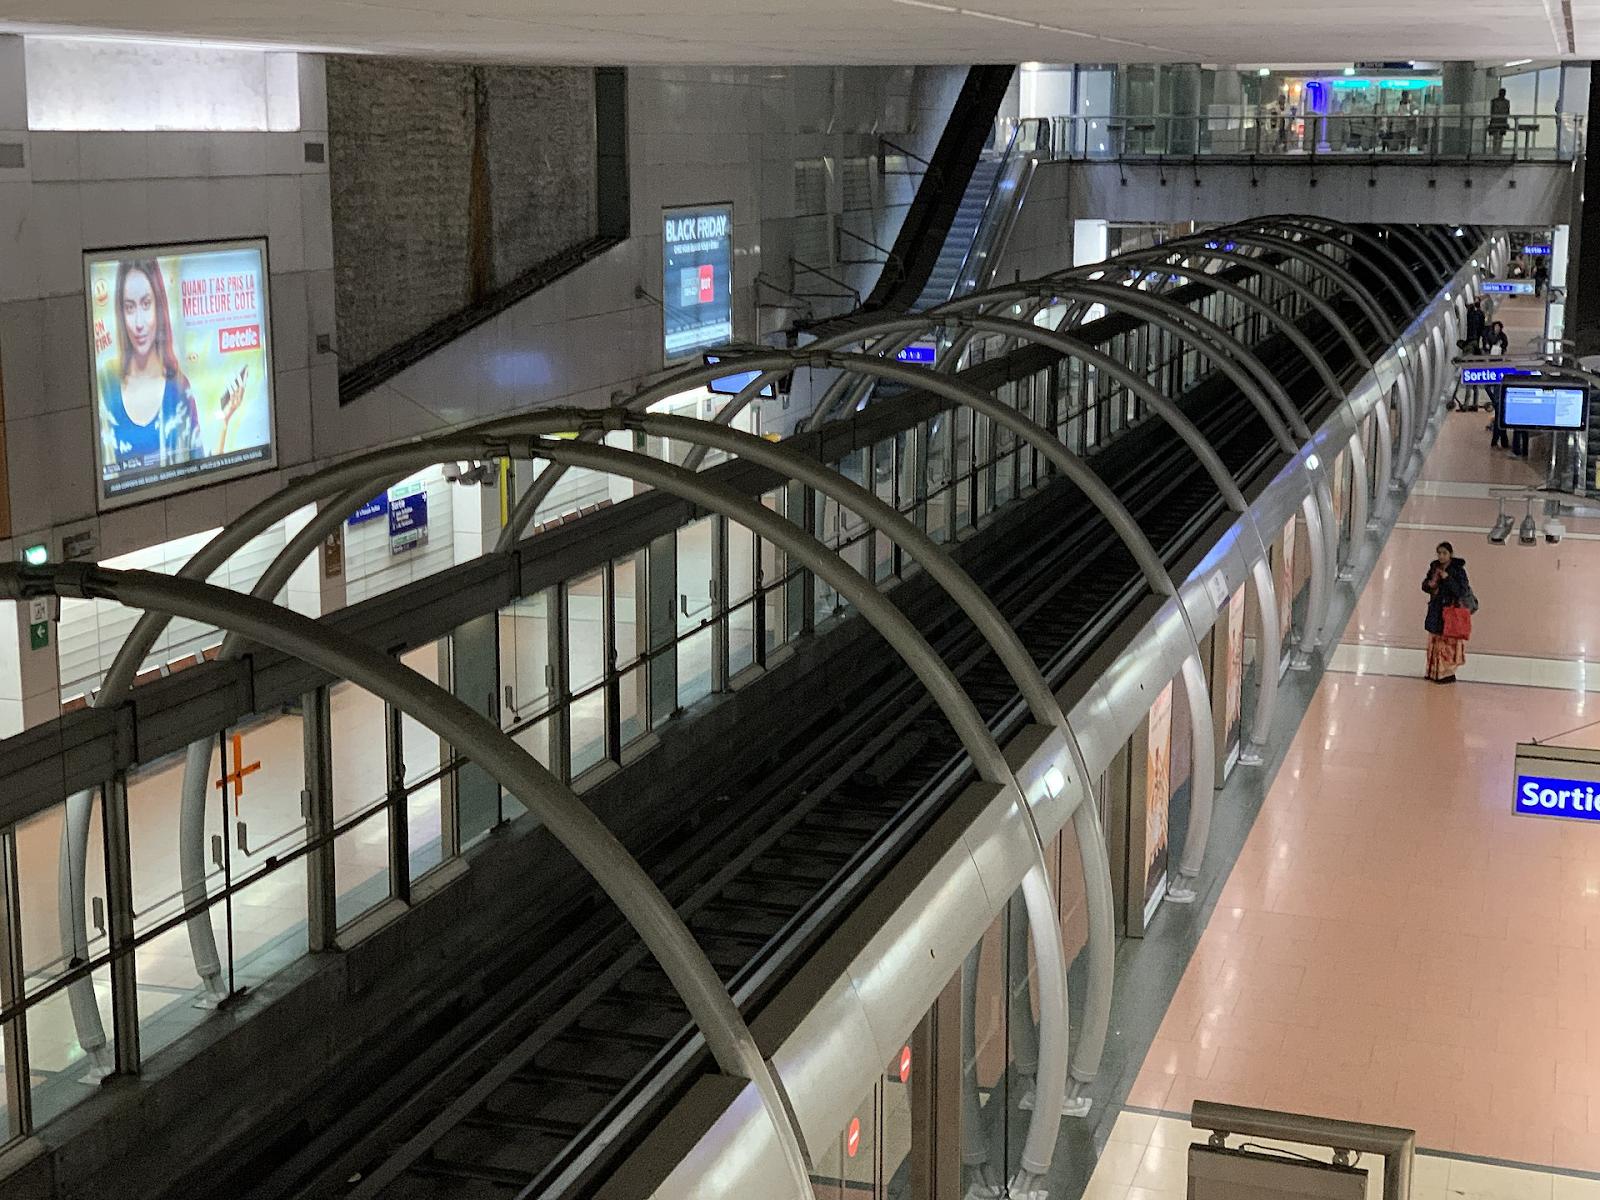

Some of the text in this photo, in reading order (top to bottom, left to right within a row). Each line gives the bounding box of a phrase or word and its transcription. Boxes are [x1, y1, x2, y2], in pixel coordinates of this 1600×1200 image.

[666, 215, 727, 242] BLACK FRIDAY
[181, 273, 255, 297] QUAND T'AS PRIS LA
[182, 291, 256, 318] MEILLEURE COTE
[95, 332, 112, 353] FIRE
[221, 328, 258, 349] Betclic
[1464, 370, 1497, 382] Sortie
